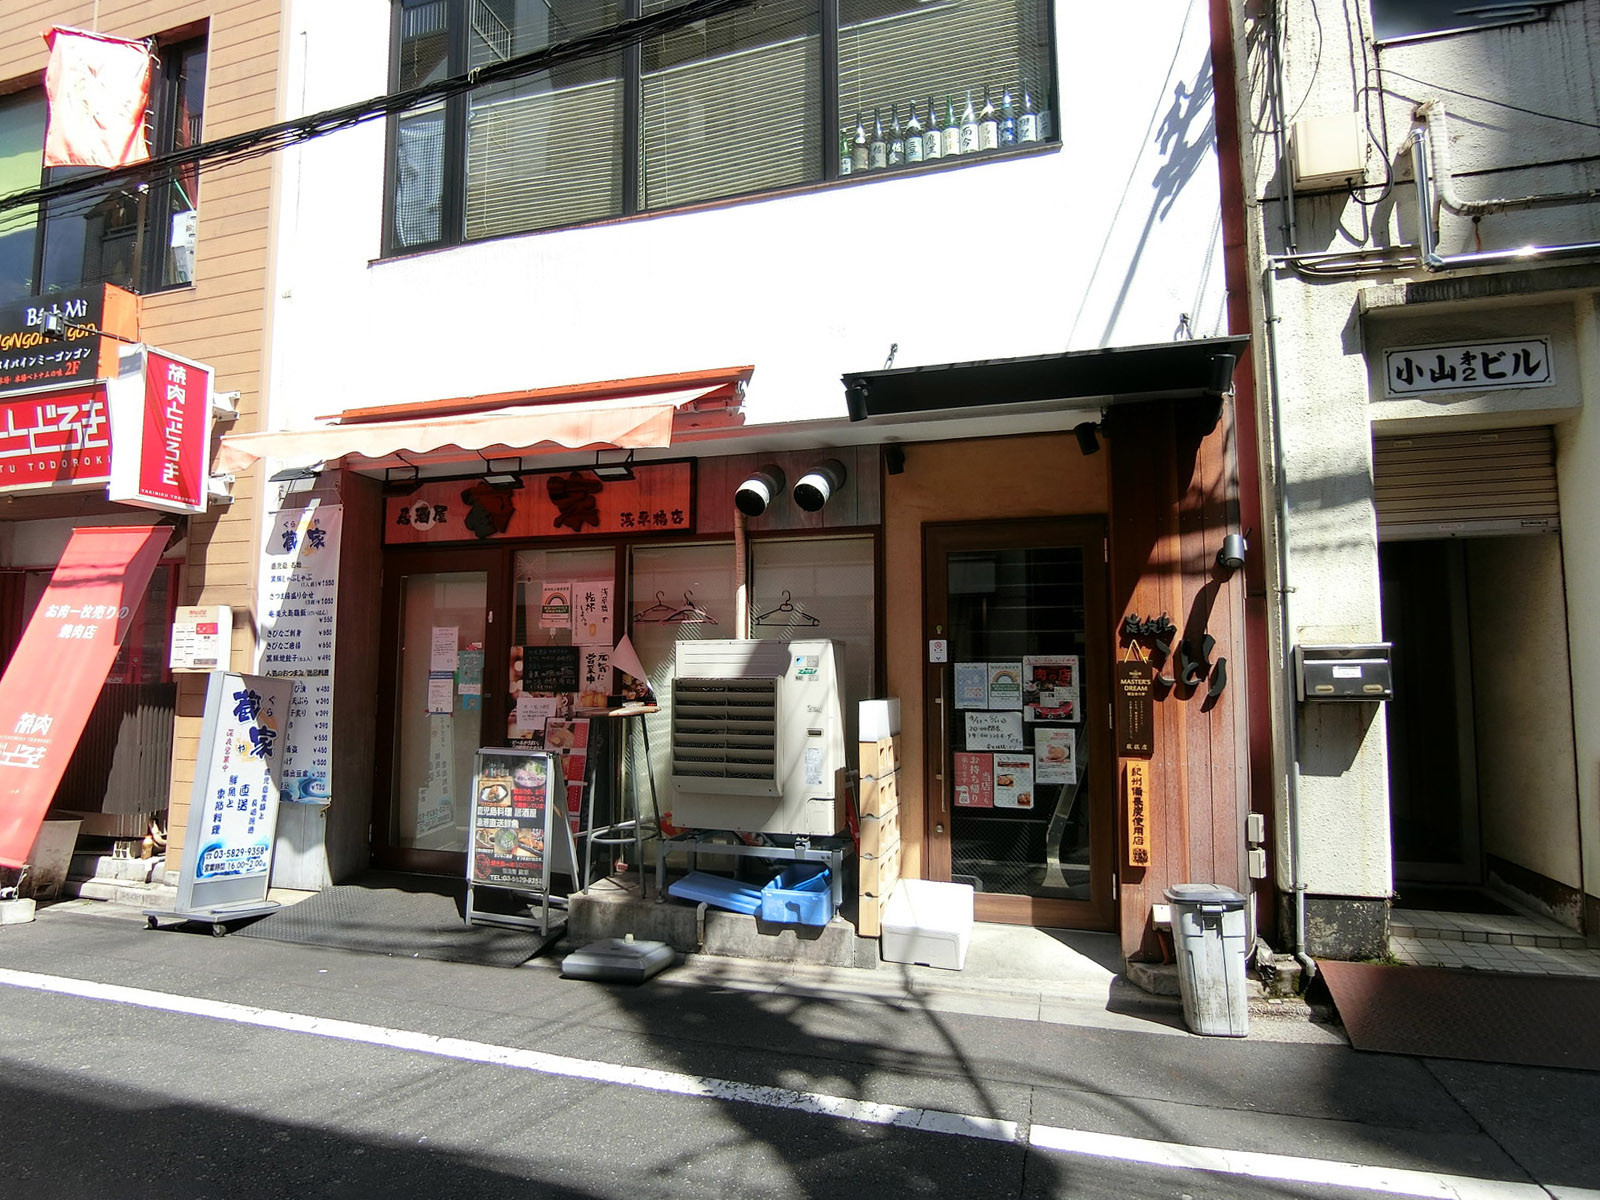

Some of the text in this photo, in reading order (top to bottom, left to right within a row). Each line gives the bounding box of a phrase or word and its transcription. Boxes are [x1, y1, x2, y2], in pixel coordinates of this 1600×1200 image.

[65, 360, 81, 376] 2F
[44, 604, 129, 620] お肉一枚売りの
[586, 652, 596, 684] 営業中
[266, 695, 276, 718] くら
[970, 756, 980, 804] お持ち帰り
